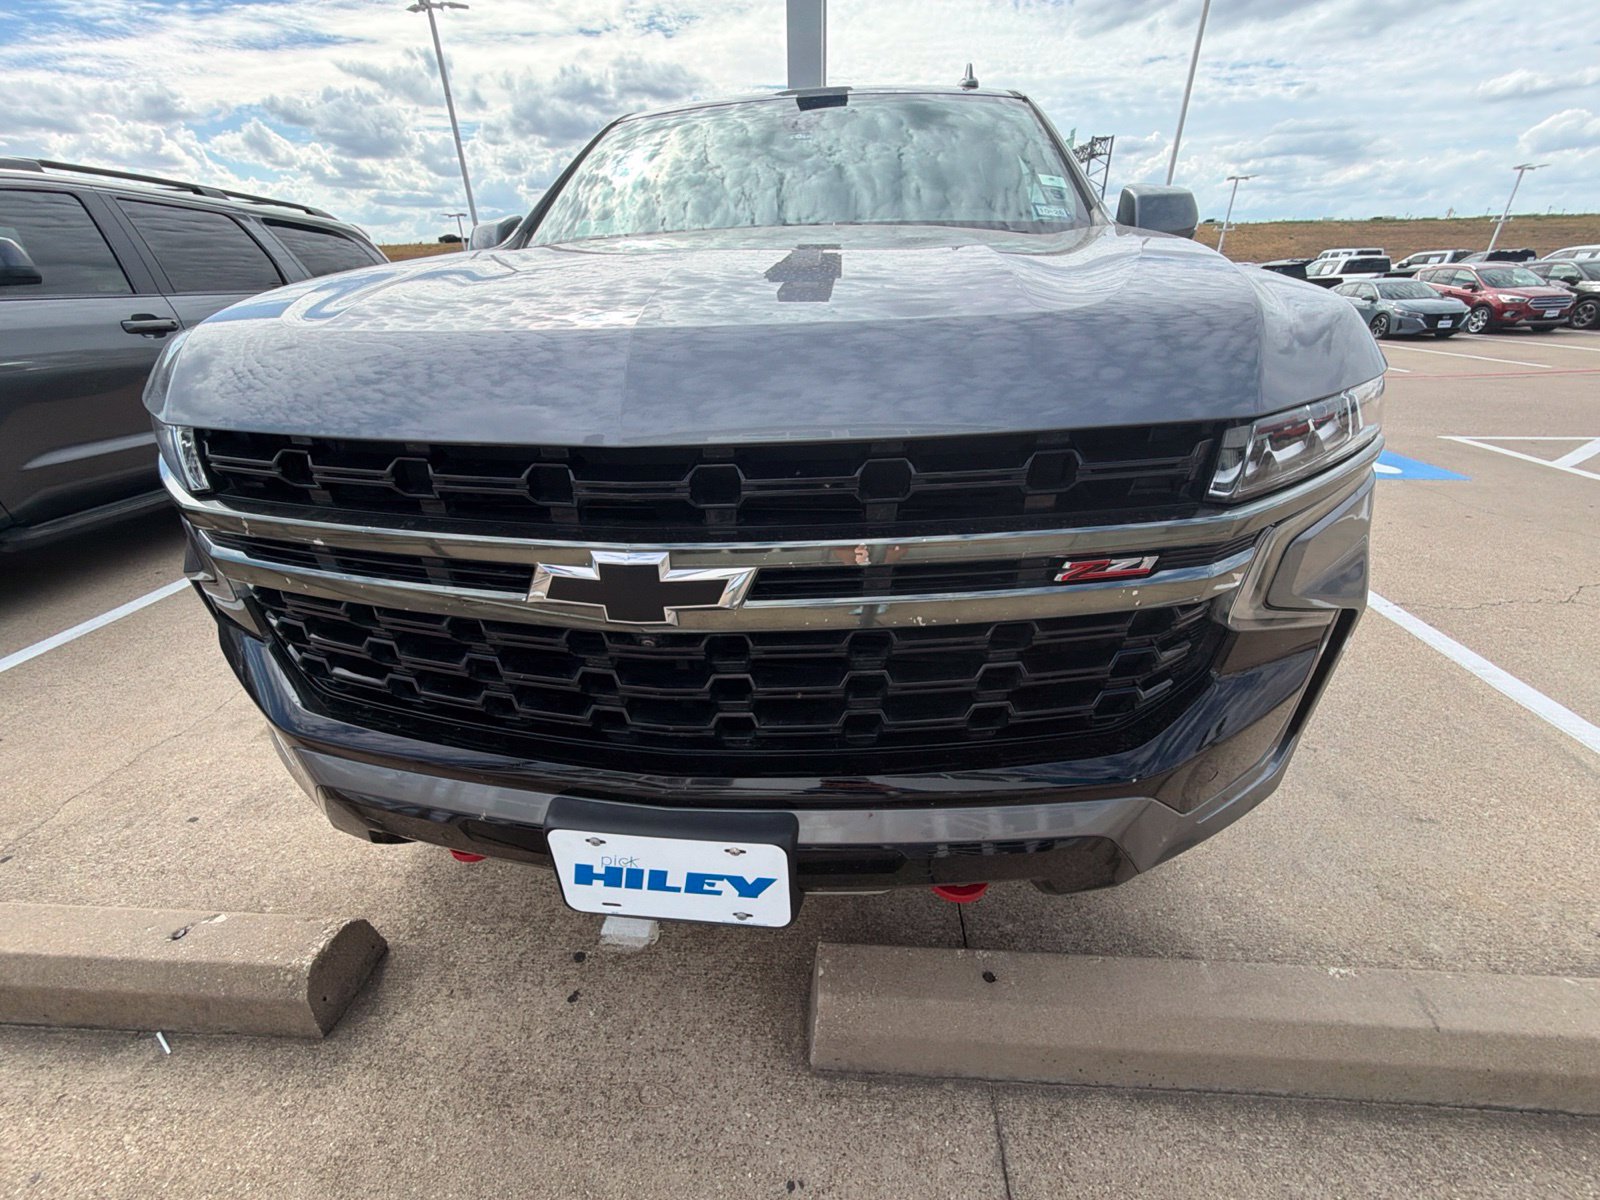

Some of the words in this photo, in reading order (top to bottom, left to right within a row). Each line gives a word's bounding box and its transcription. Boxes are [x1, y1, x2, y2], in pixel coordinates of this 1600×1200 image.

[1054, 556, 1159, 581] Z71
[601, 855, 640, 868] pick
[574, 863, 778, 899] HILEY
